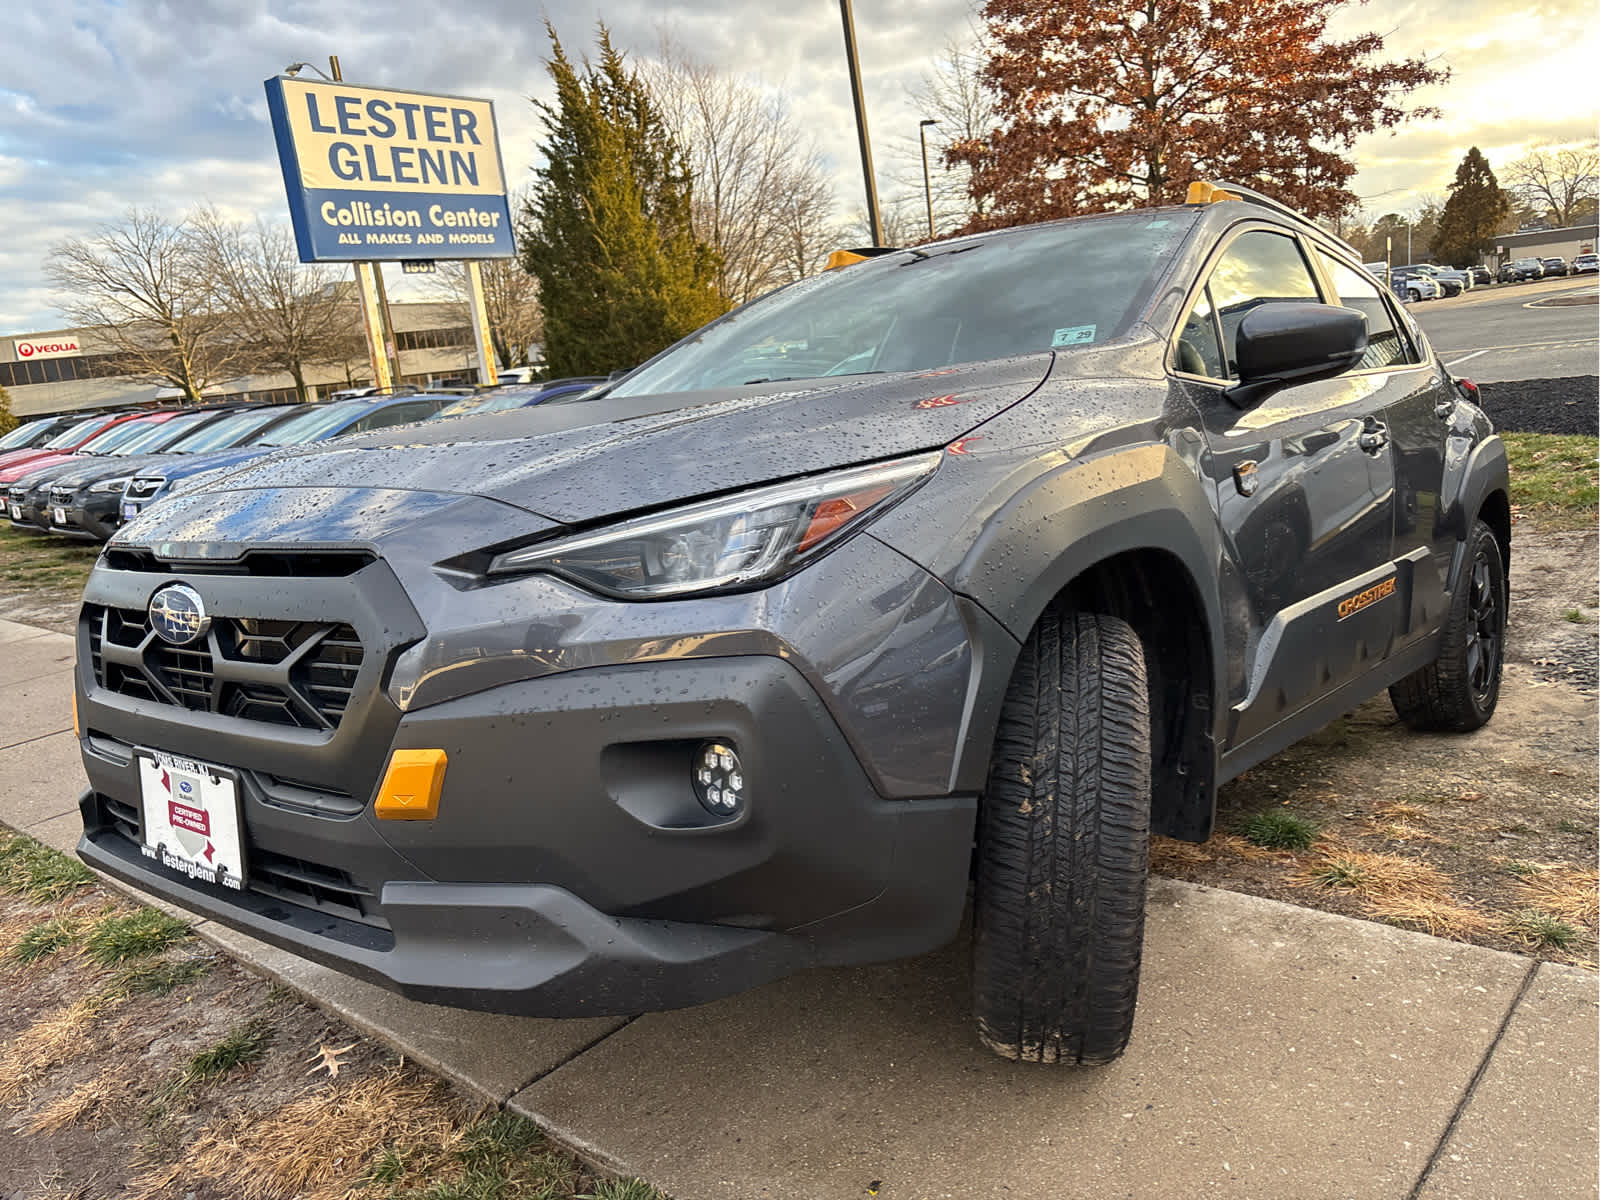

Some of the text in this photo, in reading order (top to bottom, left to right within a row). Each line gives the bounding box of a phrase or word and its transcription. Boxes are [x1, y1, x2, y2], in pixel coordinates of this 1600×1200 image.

[305, 92, 482, 146] LESTER
[328, 142, 479, 186] GLENN
[320, 201, 500, 228] Collision Center
[338, 233, 495, 244] ALL MAKES AND MODELS
[1060, 333, 1068, 341] 7
[35, 343, 78, 353] VEOLIA
[174, 806, 203, 821] CERTIFIED
[172, 814, 206, 831] PRE-OWNED
[162, 848, 216, 884] lesterglenn
